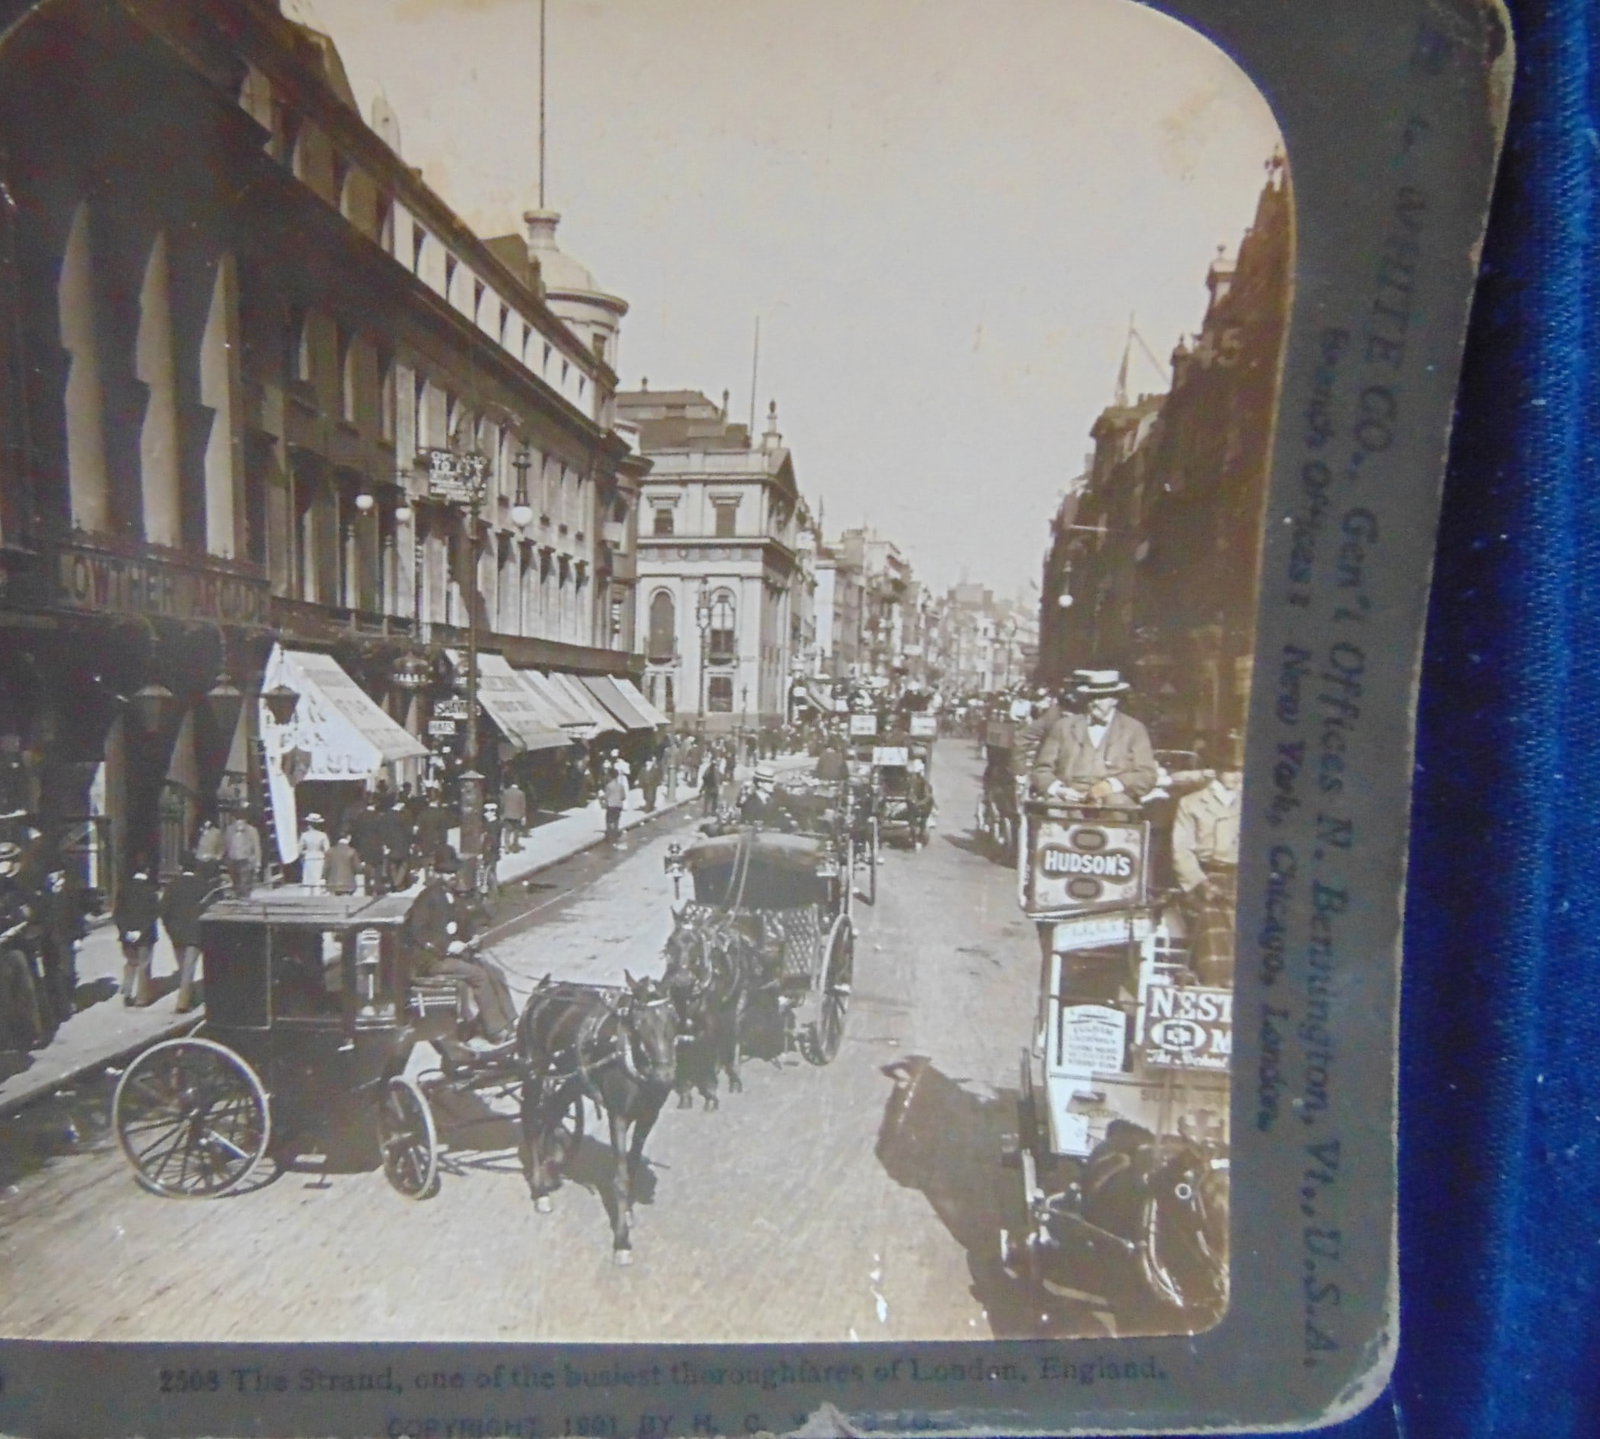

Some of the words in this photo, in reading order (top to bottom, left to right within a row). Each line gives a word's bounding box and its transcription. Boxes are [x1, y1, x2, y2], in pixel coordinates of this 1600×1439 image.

[1275, 643, 1311, 726] New
[1317, 642, 1366, 794] Offices
[1044, 850, 1131, 877] HUDSON'S
[1312, 816, 1354, 862] N.
[1297, 881, 1349, 1125] Bennington,
[1302, 1228, 1341, 1367] U.S.A.
[232, 1369, 288, 1392] The
[299, 1367, 403, 1395] Strand,
[414, 1371, 464, 1390] one
[475, 1365, 505, 1390] of
[510, 1366, 556, 1390] the
[670, 1361, 864, 1390] thoroughfares
[874, 1356, 903, 1382] of
[641, 1415, 674, 1436] BY
